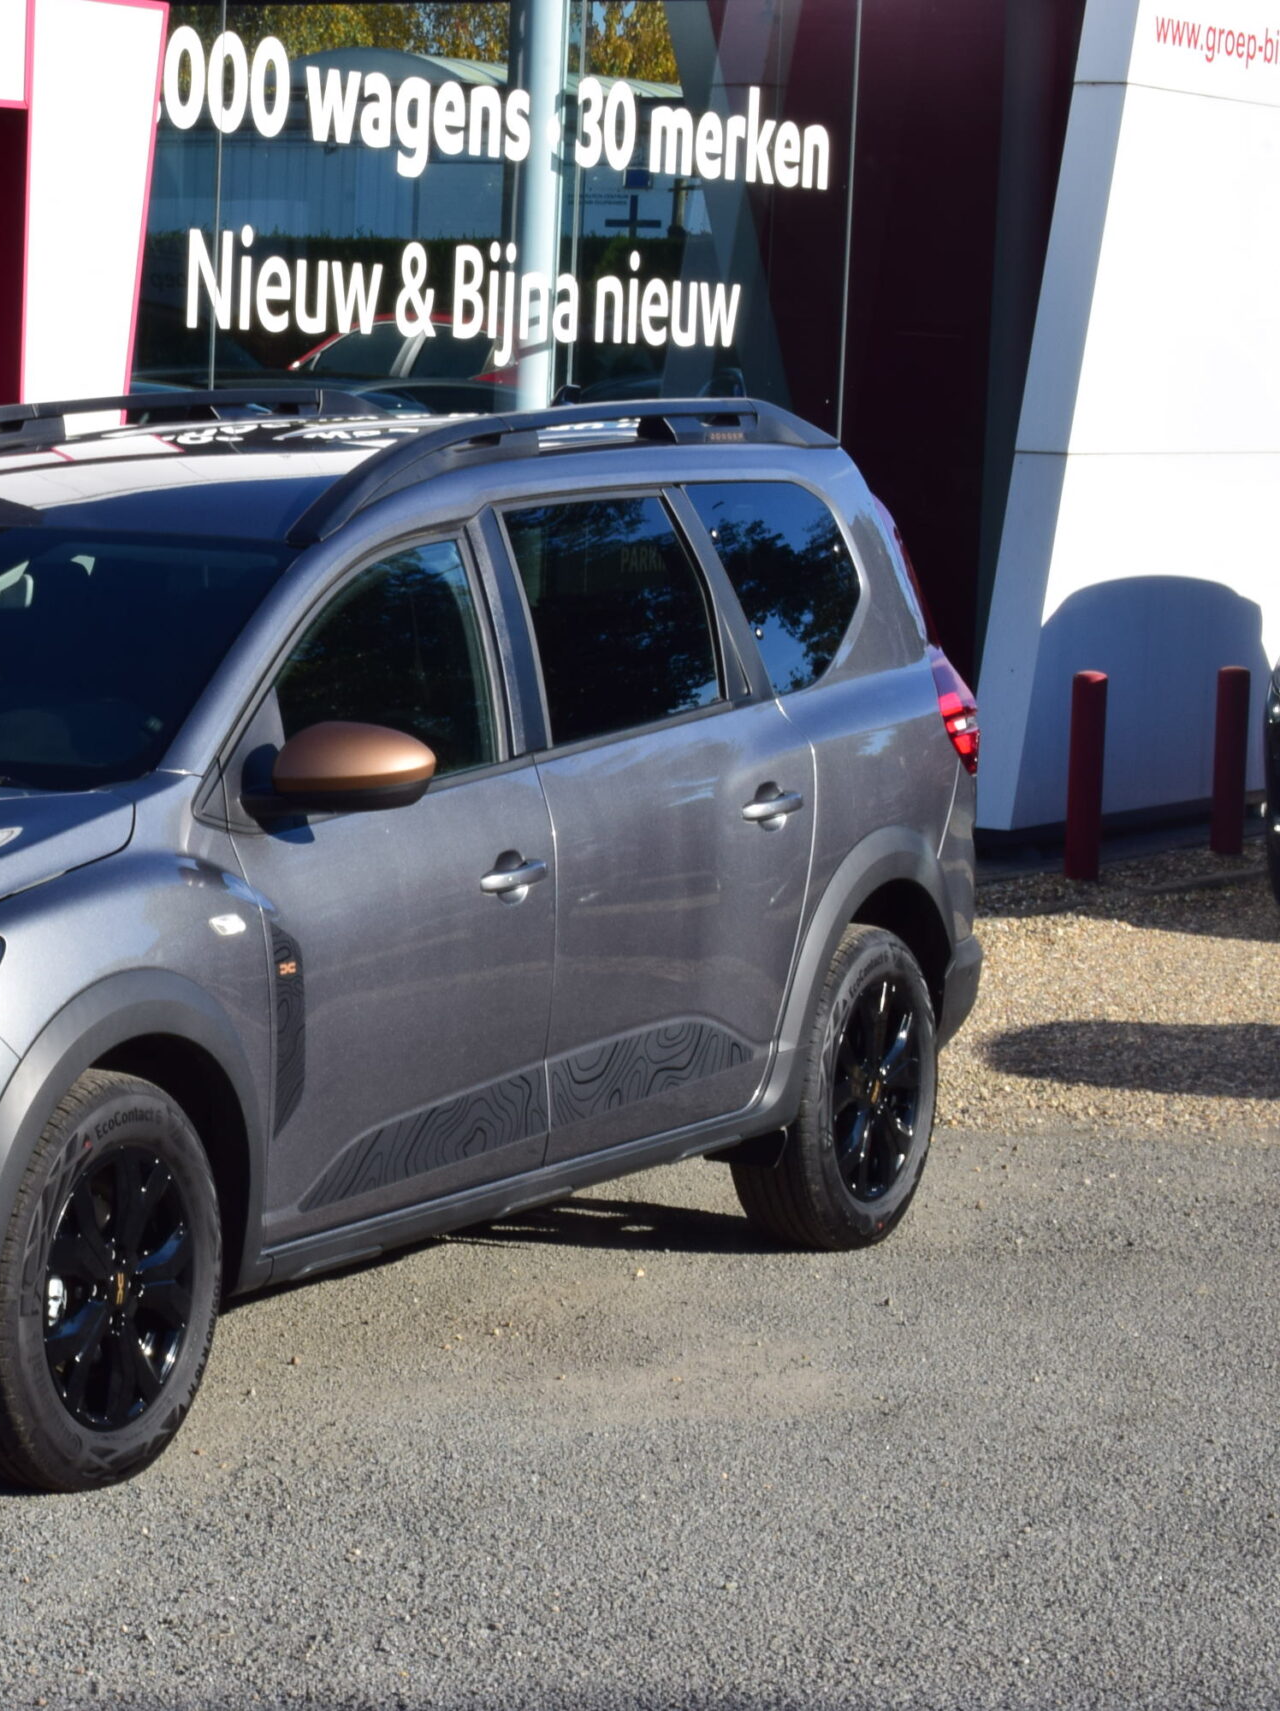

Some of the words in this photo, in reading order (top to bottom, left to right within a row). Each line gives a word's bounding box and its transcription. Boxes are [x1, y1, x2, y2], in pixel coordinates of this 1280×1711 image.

[305, 66, 531, 178] wagens
[575, 76, 637, 171] 30
[648, 86, 831, 191] merken
[185, 224, 383, 336] Nieuw
[395, 241, 437, 340] &
[452, 241, 579, 367] Bijna
[594, 249, 741, 349] nieuw
[94, 1106, 154, 1141] EcoContact
